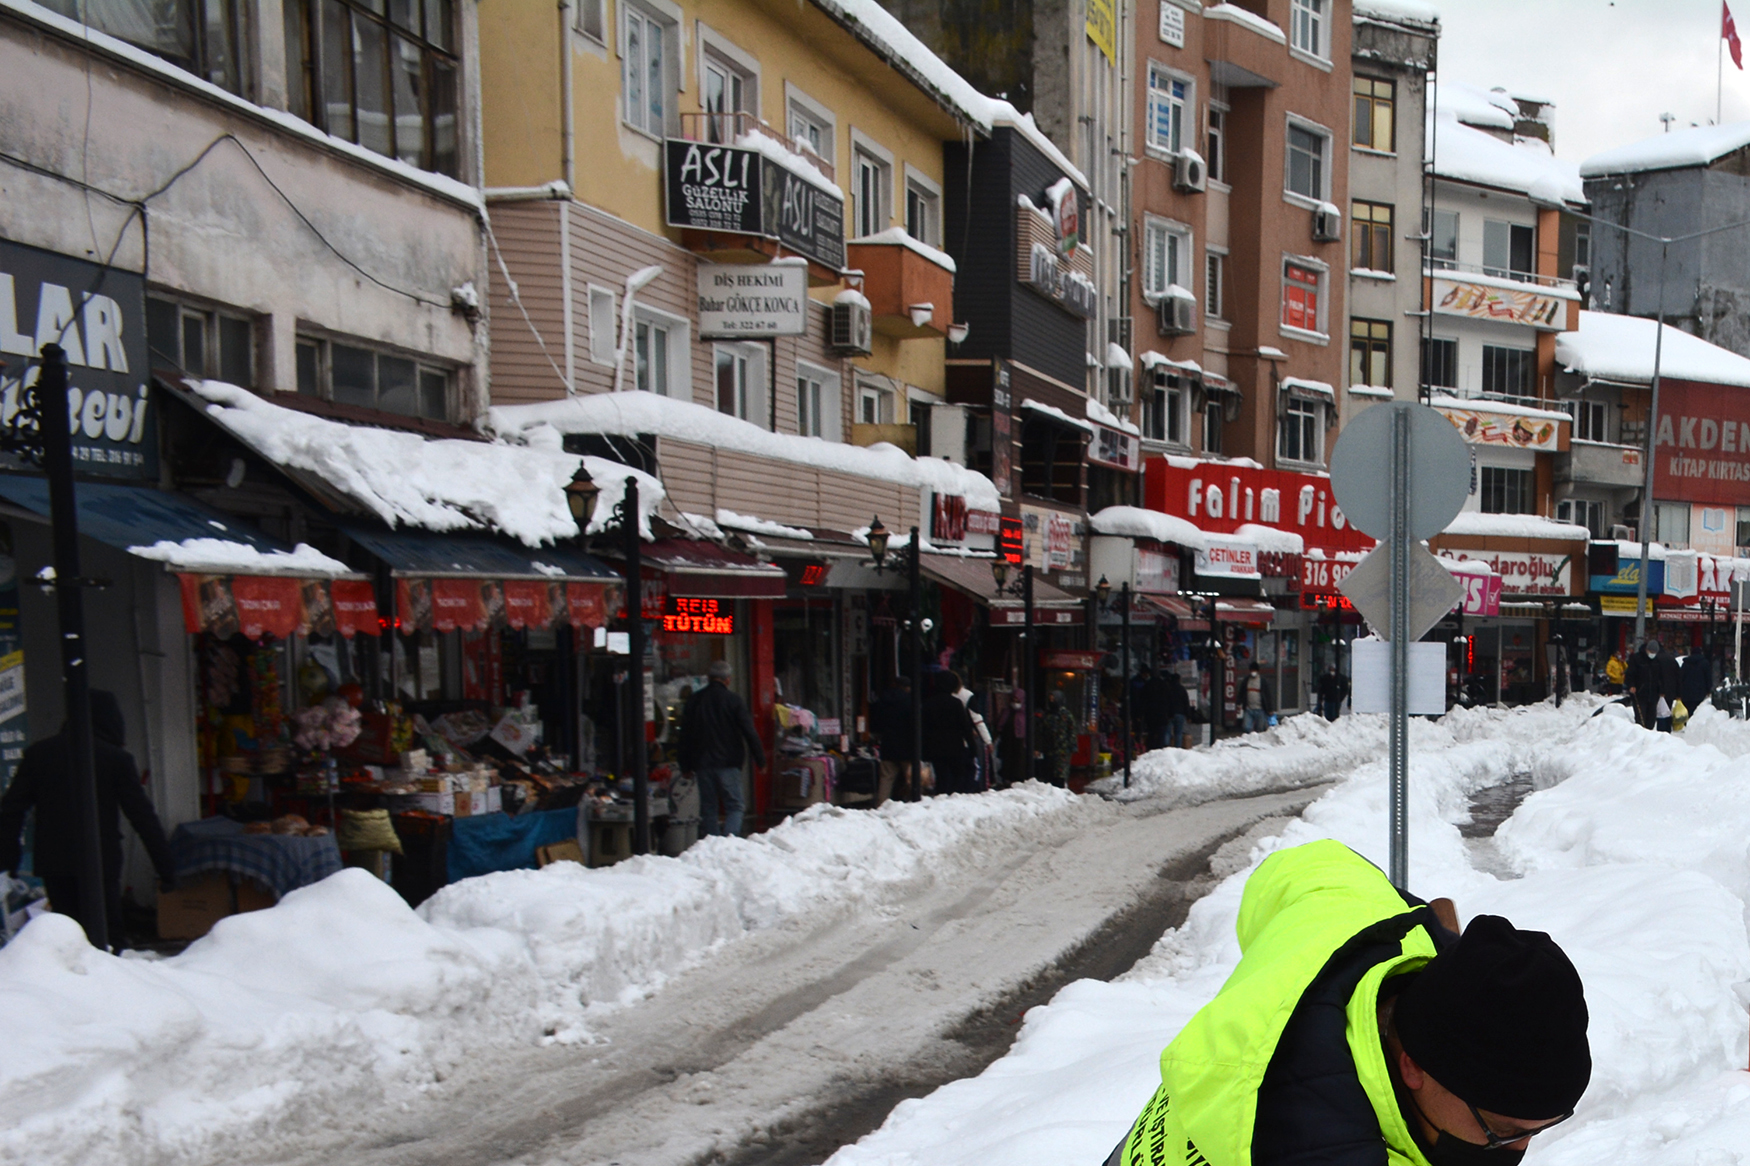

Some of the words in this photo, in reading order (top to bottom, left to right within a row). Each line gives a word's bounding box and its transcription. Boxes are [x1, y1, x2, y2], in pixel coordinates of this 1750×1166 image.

[680, 144, 750, 189] ASLI
[685, 196, 744, 214] SALONU
[782, 172, 813, 239] ASLI
[714, 272, 735, 288] DİŞ
[737, 272, 784, 287] HEKİMİ
[726, 292, 762, 316] GÖKÇE
[764, 297, 800, 313] KONCA
[1668, 452, 1707, 478] KİTAP
[1208, 546, 1254, 567] ÇETİNLER
[1303, 560, 1329, 587] 316
[663, 612, 734, 635] TÜTÜN
